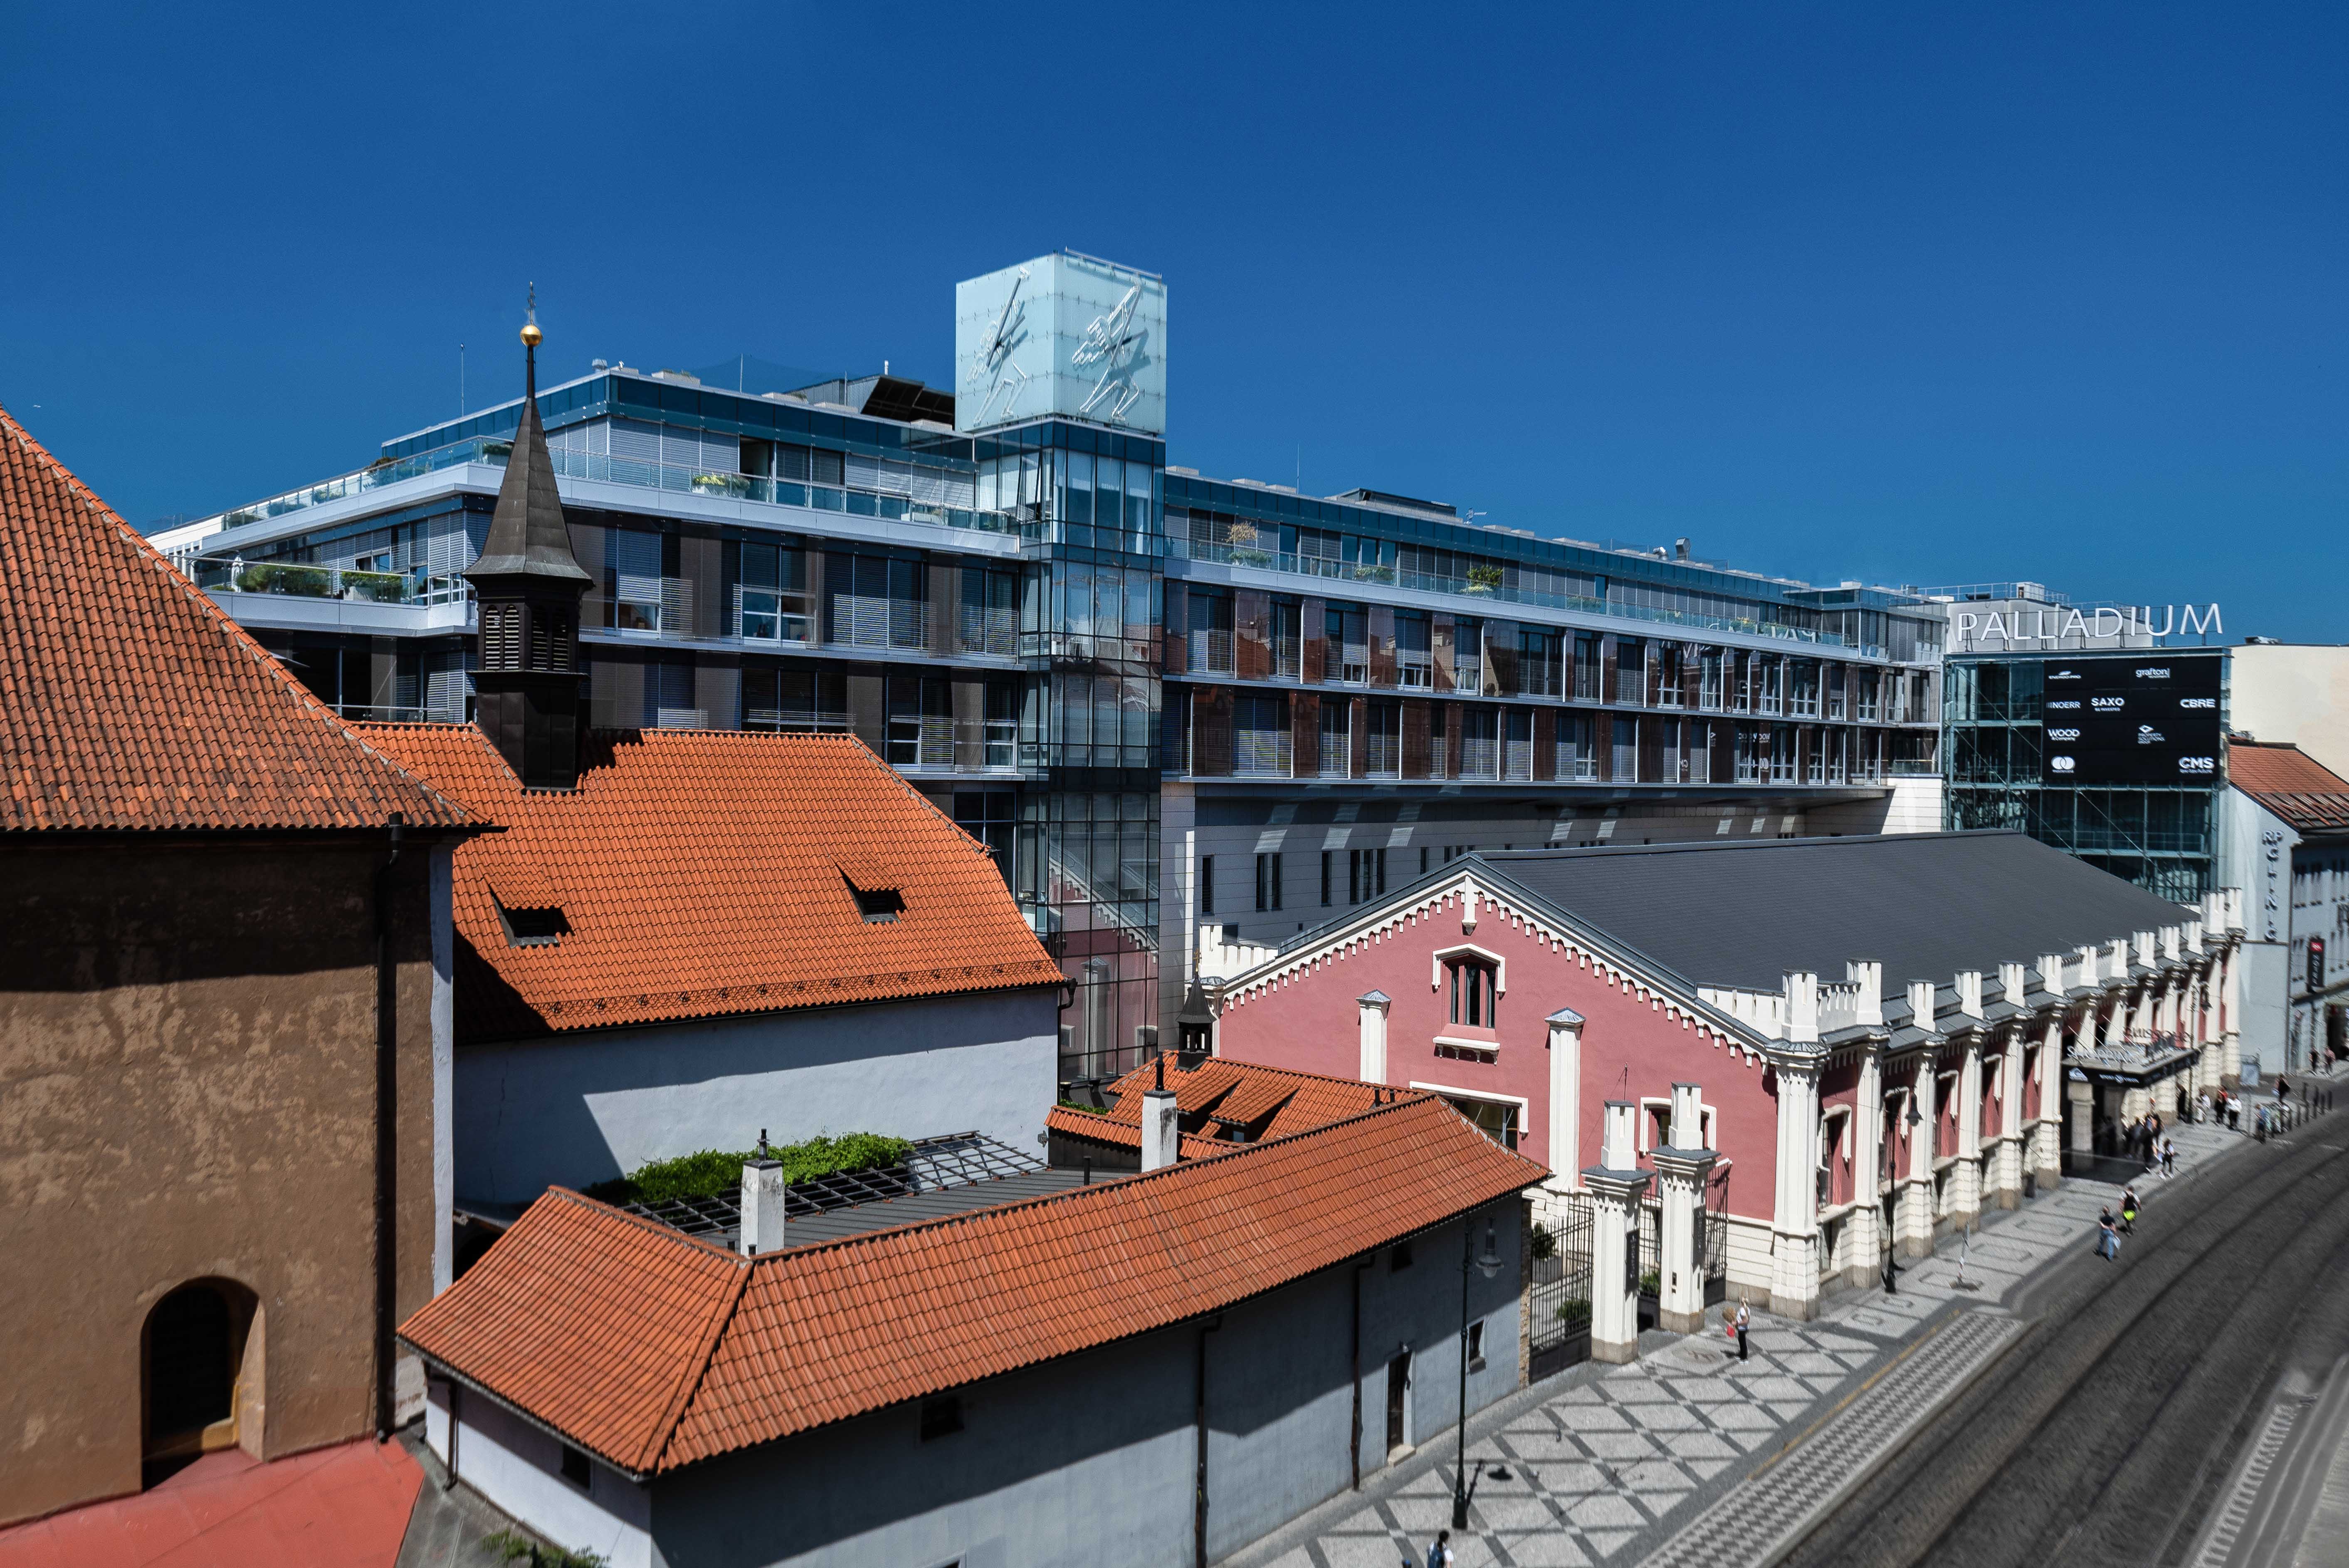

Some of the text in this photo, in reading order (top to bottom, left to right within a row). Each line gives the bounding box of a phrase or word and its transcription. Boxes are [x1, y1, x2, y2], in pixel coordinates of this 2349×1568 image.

[1958, 603, 2223, 642] PALLADIUM
[2136, 668, 2167, 678] grafton
[2091, 697, 2125, 706] SAXO
[2180, 699, 2216, 708] CBRE
[2048, 728, 2081, 737] WOOD
[2179, 757, 2215, 769] CMS
